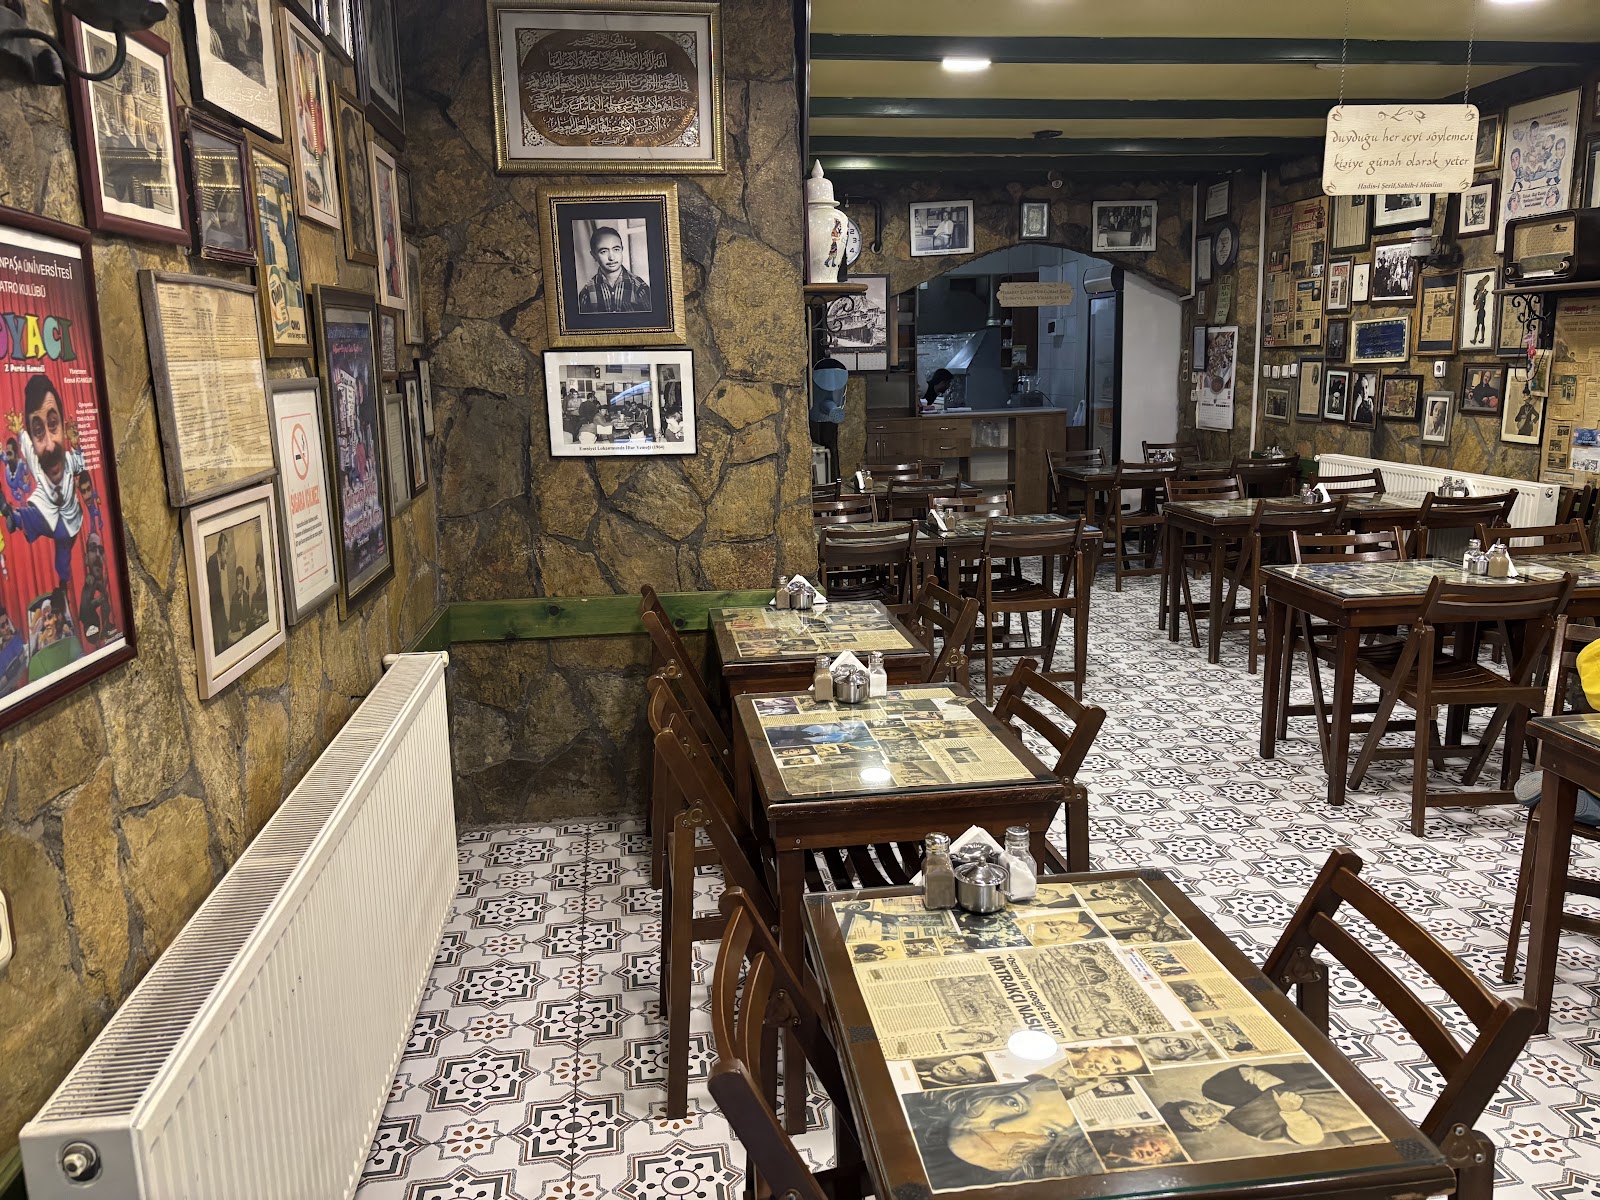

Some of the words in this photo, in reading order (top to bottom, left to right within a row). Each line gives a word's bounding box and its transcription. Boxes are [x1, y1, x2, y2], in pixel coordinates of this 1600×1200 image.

[1382, 126, 1400, 142] her
[1425, 126, 1475, 148] söylemesi
[1365, 151, 1402, 176] günah
[1406, 150, 1442, 169] olarak
[1438, 154, 1470, 173] yeter
[1419, 181, 1443, 189] Müslim
[23, 255, 73, 280] ÜNİVERSİTESİ
[19, 283, 47, 298] KULÜBÜ
[4, 364, 9, 373] 2
[986, 955, 1028, 1004] MATRAKÇI
[1015, 1004, 1049, 1036] NASU
[1027, 990, 1047, 1012] Google
